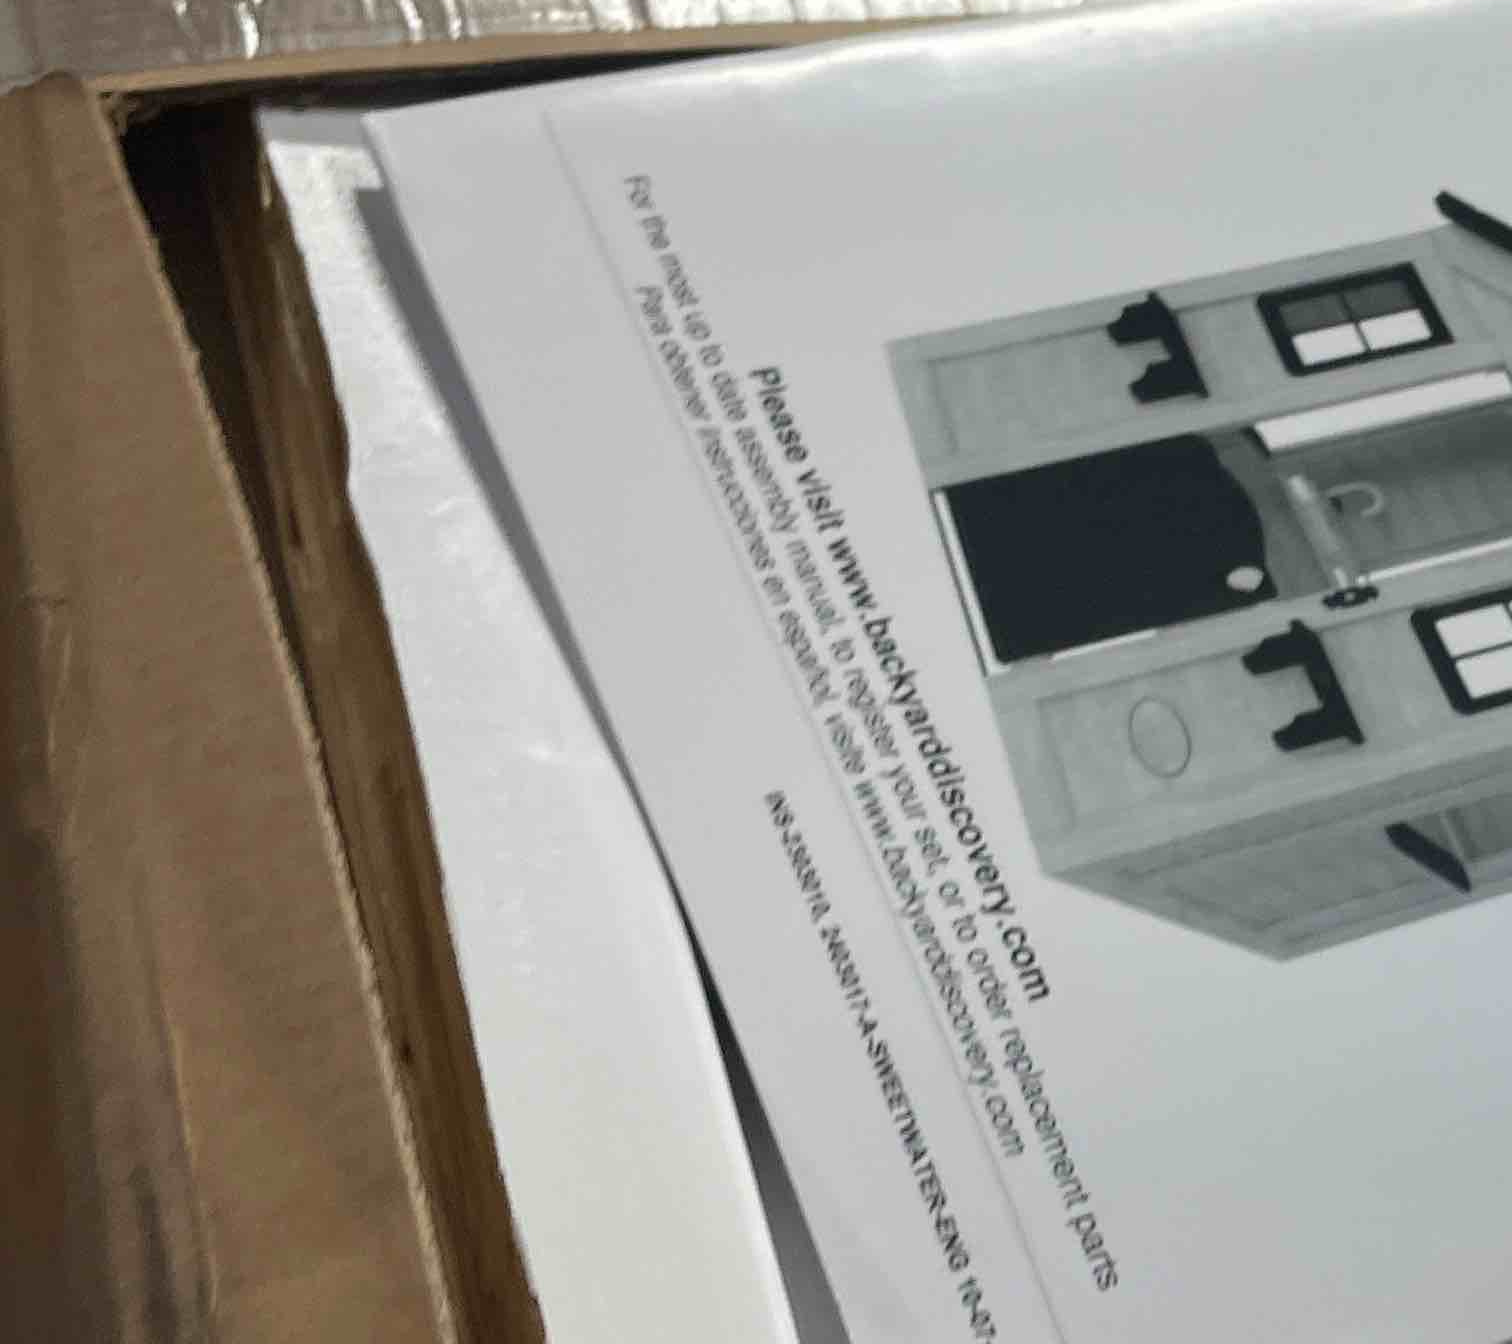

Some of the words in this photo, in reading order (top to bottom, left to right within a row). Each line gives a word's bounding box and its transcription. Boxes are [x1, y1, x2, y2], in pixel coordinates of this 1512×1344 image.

[624, 175, 655, 209] For
[641, 215, 670, 250] the
[659, 253, 699, 307] most
[682, 311, 712, 341] up
[699, 344, 724, 367] to
[711, 371, 747, 422] date
[734, 426, 798, 533] assembly
[829, 637, 855, 664] to
[748, 366, 808, 462] Please
[797, 468, 845, 534] visit
[827, 537, 1051, 1002] www.backyarddiscovery.com
[843, 667, 900, 758] register
[879, 763, 928, 821] your
[938, 880, 966, 911] or
[952, 913, 979, 943] to
[853, 779, 1025, 1159] www.backyarddiscovery.com
[967, 947, 1014, 1021] order
[999, 1026, 1090, 1211] replacement
[1065, 1211, 1119, 1293] parts
